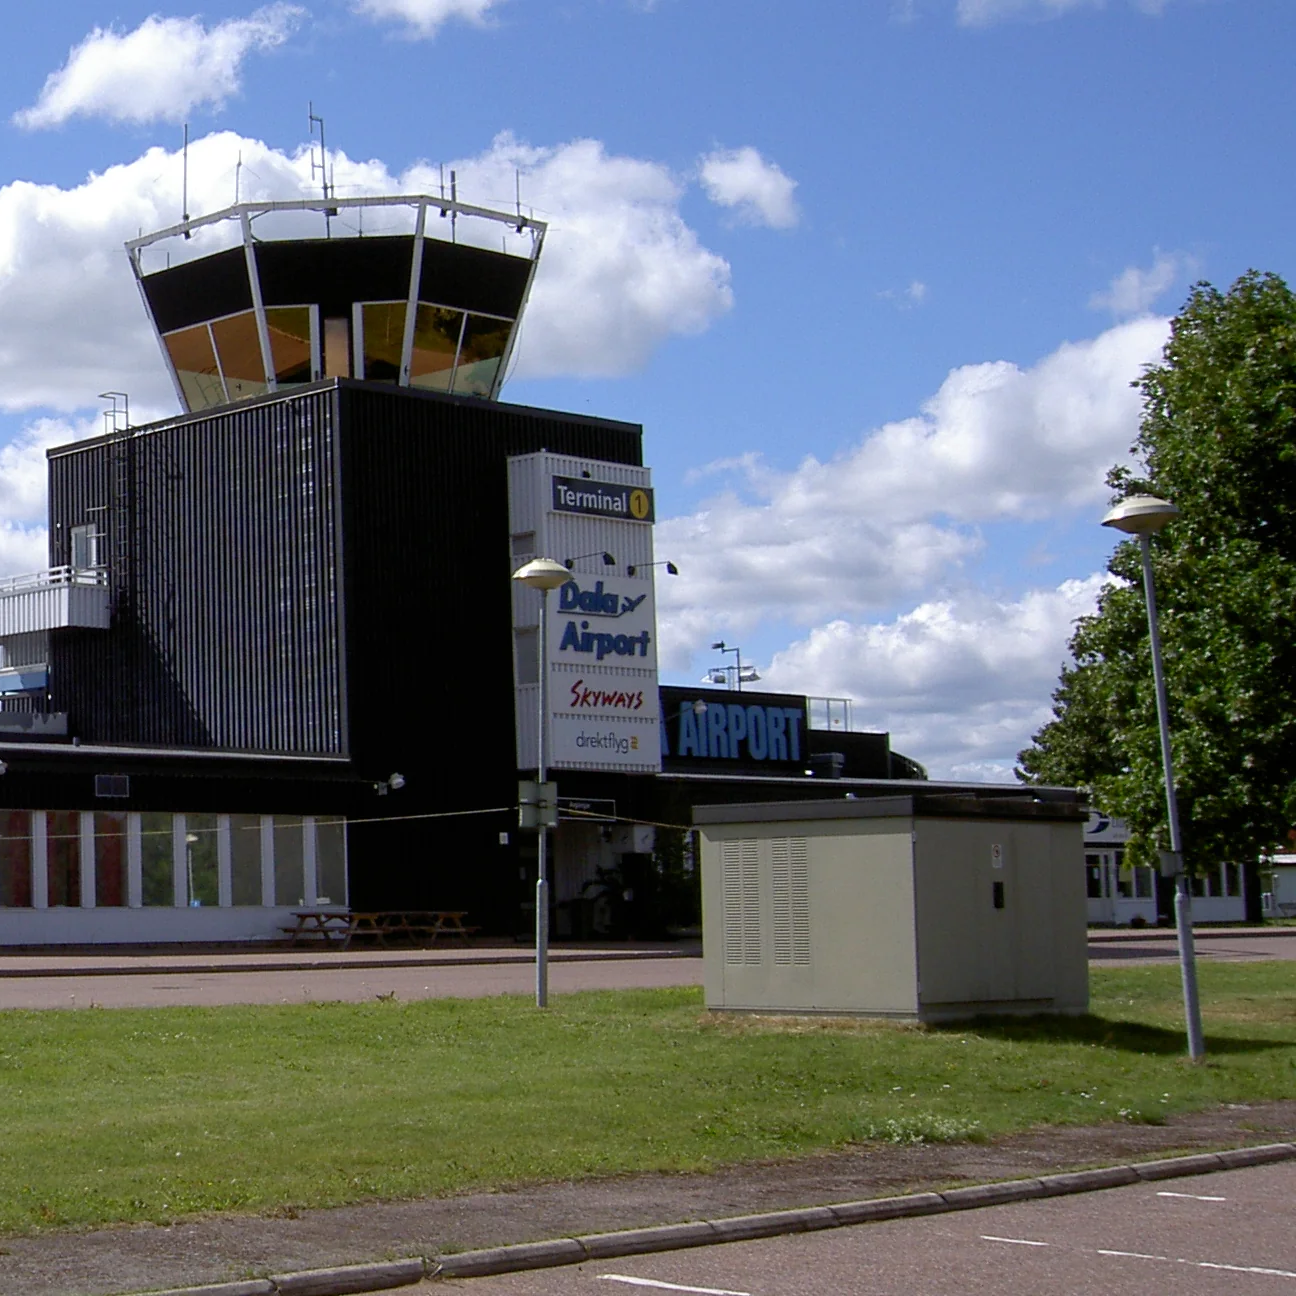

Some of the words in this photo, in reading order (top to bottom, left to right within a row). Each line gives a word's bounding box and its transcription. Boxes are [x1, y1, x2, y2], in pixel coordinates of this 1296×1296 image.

[557, 485, 627, 512] Terminal
[635, 494, 642, 514] 1
[559, 580, 619, 614] Dala
[559, 620, 651, 661] Airport
[576, 731, 629, 754] direktflyg
[678, 701, 802, 760] AIRPORT
